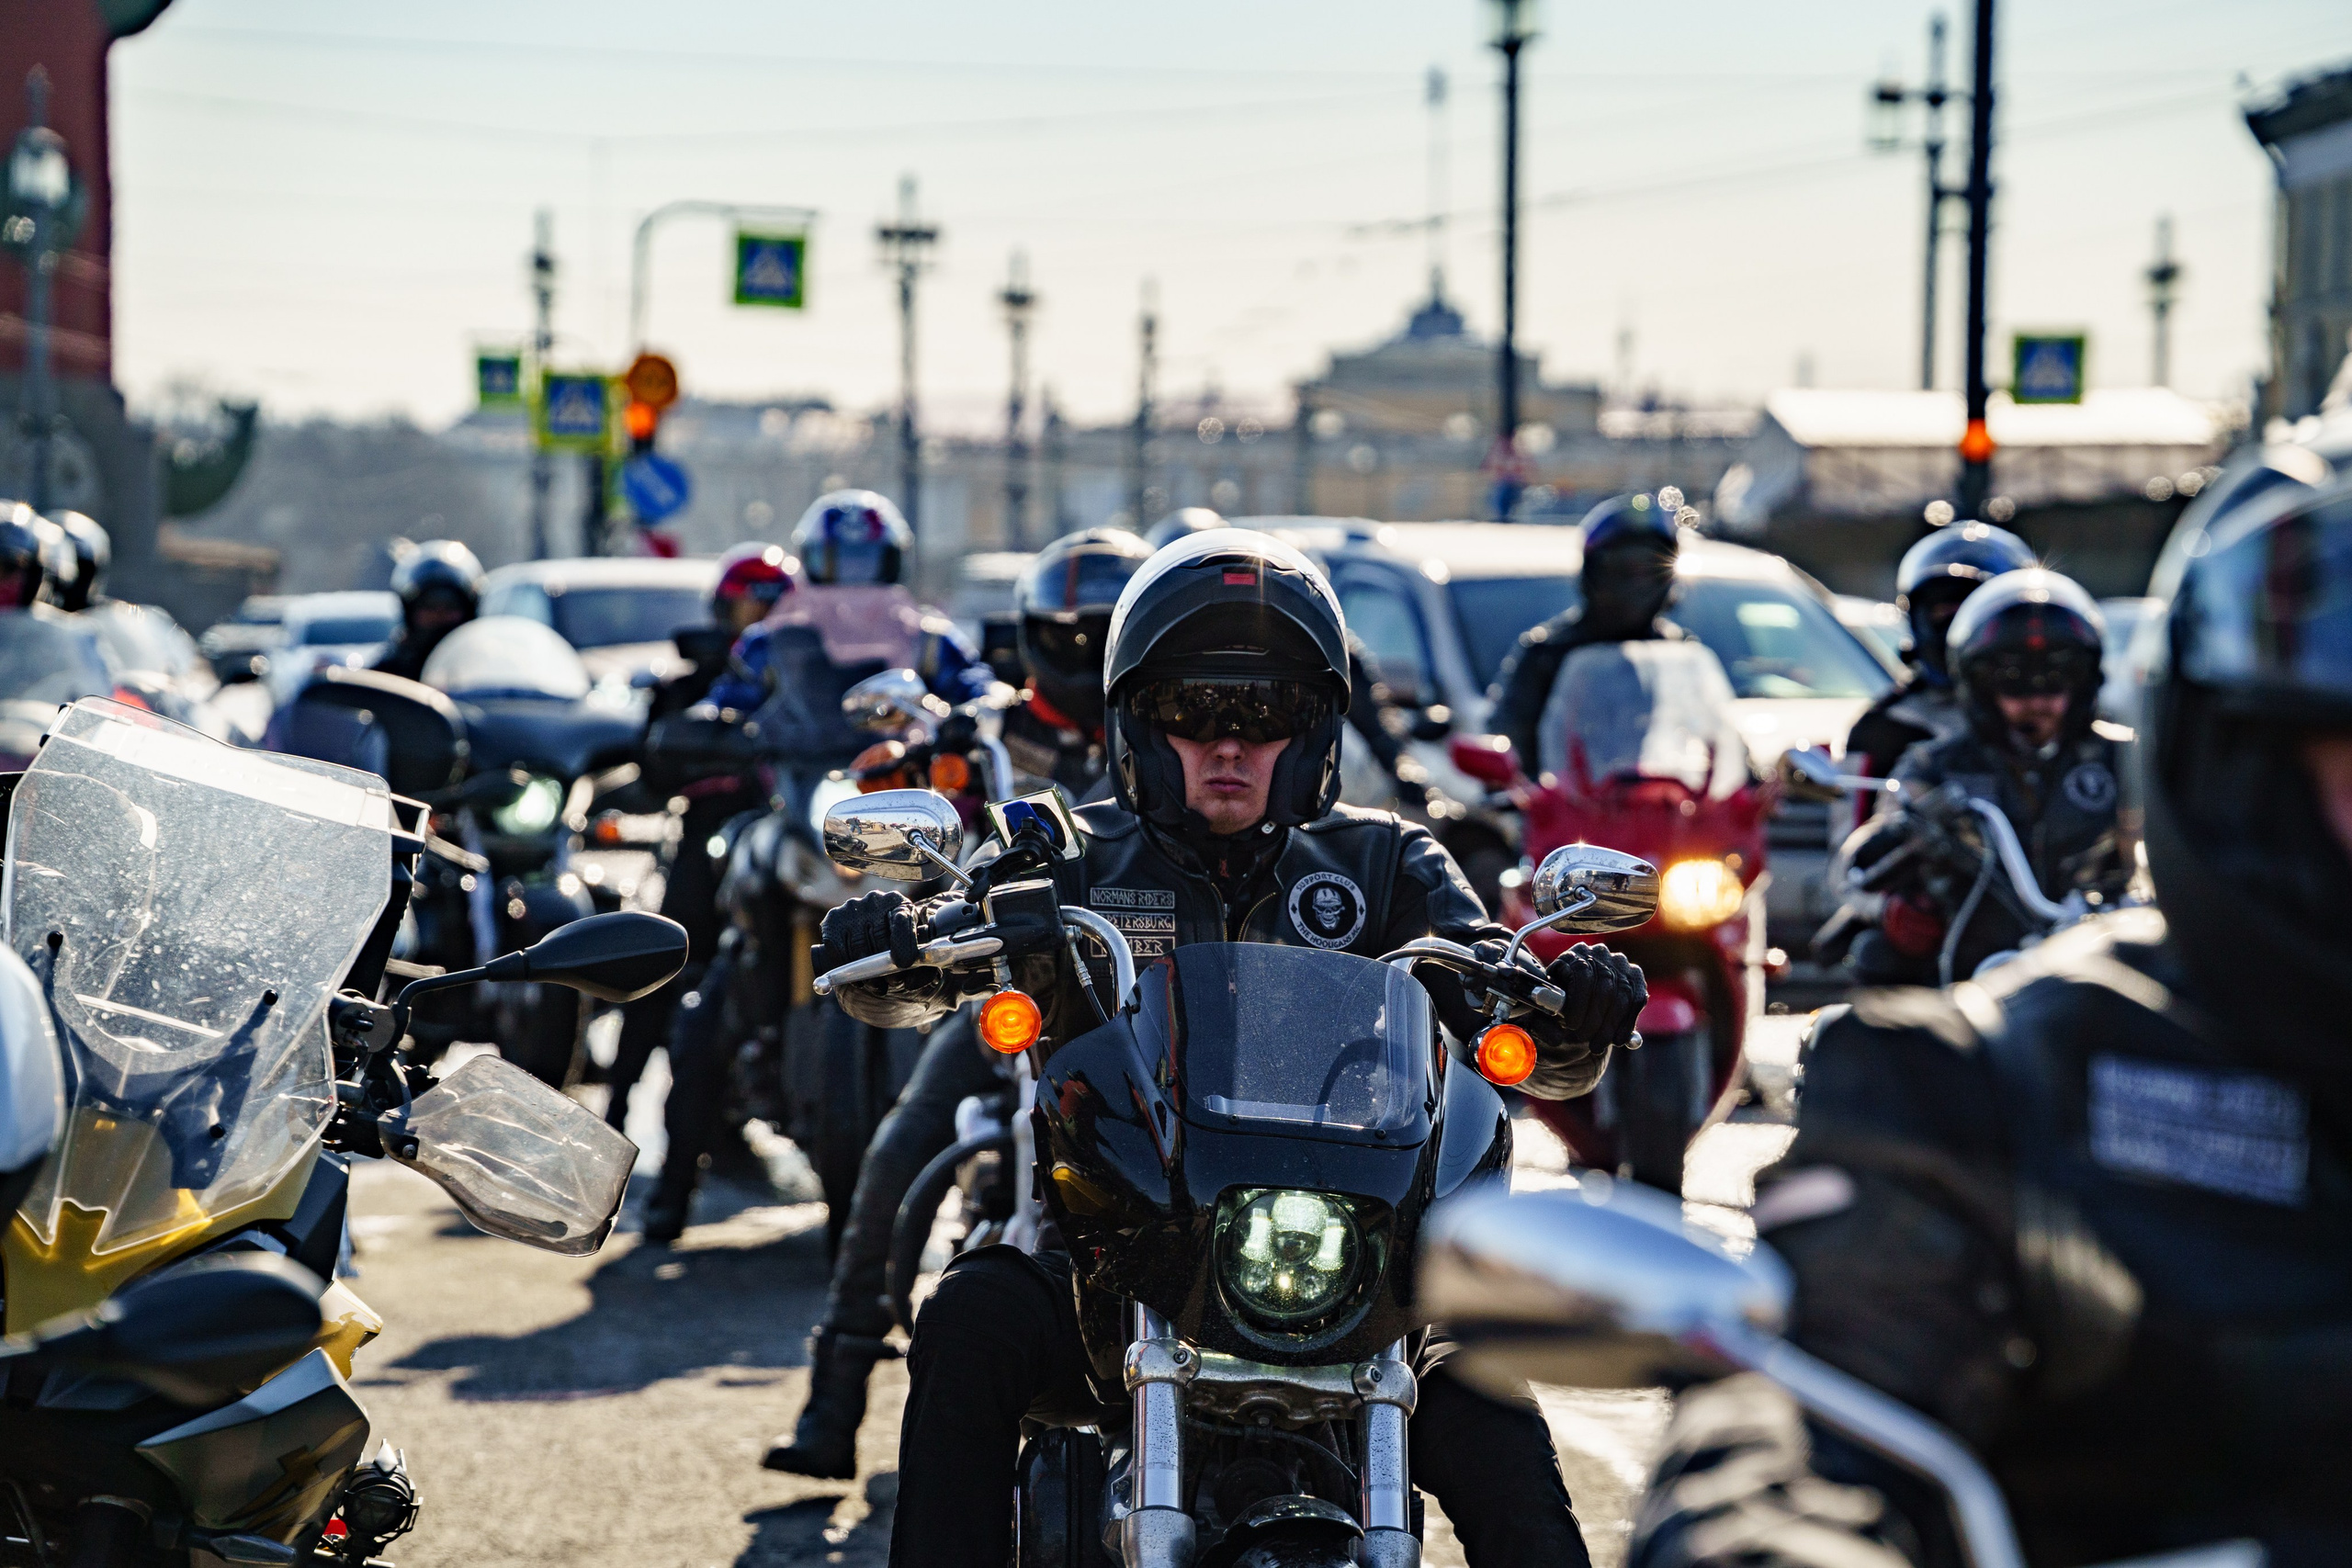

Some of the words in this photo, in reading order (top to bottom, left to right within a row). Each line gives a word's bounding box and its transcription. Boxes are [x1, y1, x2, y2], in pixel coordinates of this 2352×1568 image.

[1295, 873, 1332, 891] SUPPORT
[1334, 875, 1356, 891] CLUB
[1093, 890, 1136, 904] NORMANS
[1137, 892, 1173, 906] RIDERS
[1296, 921, 1312, 937] THE
[1309, 935, 1352, 949] HOOLIGANS
